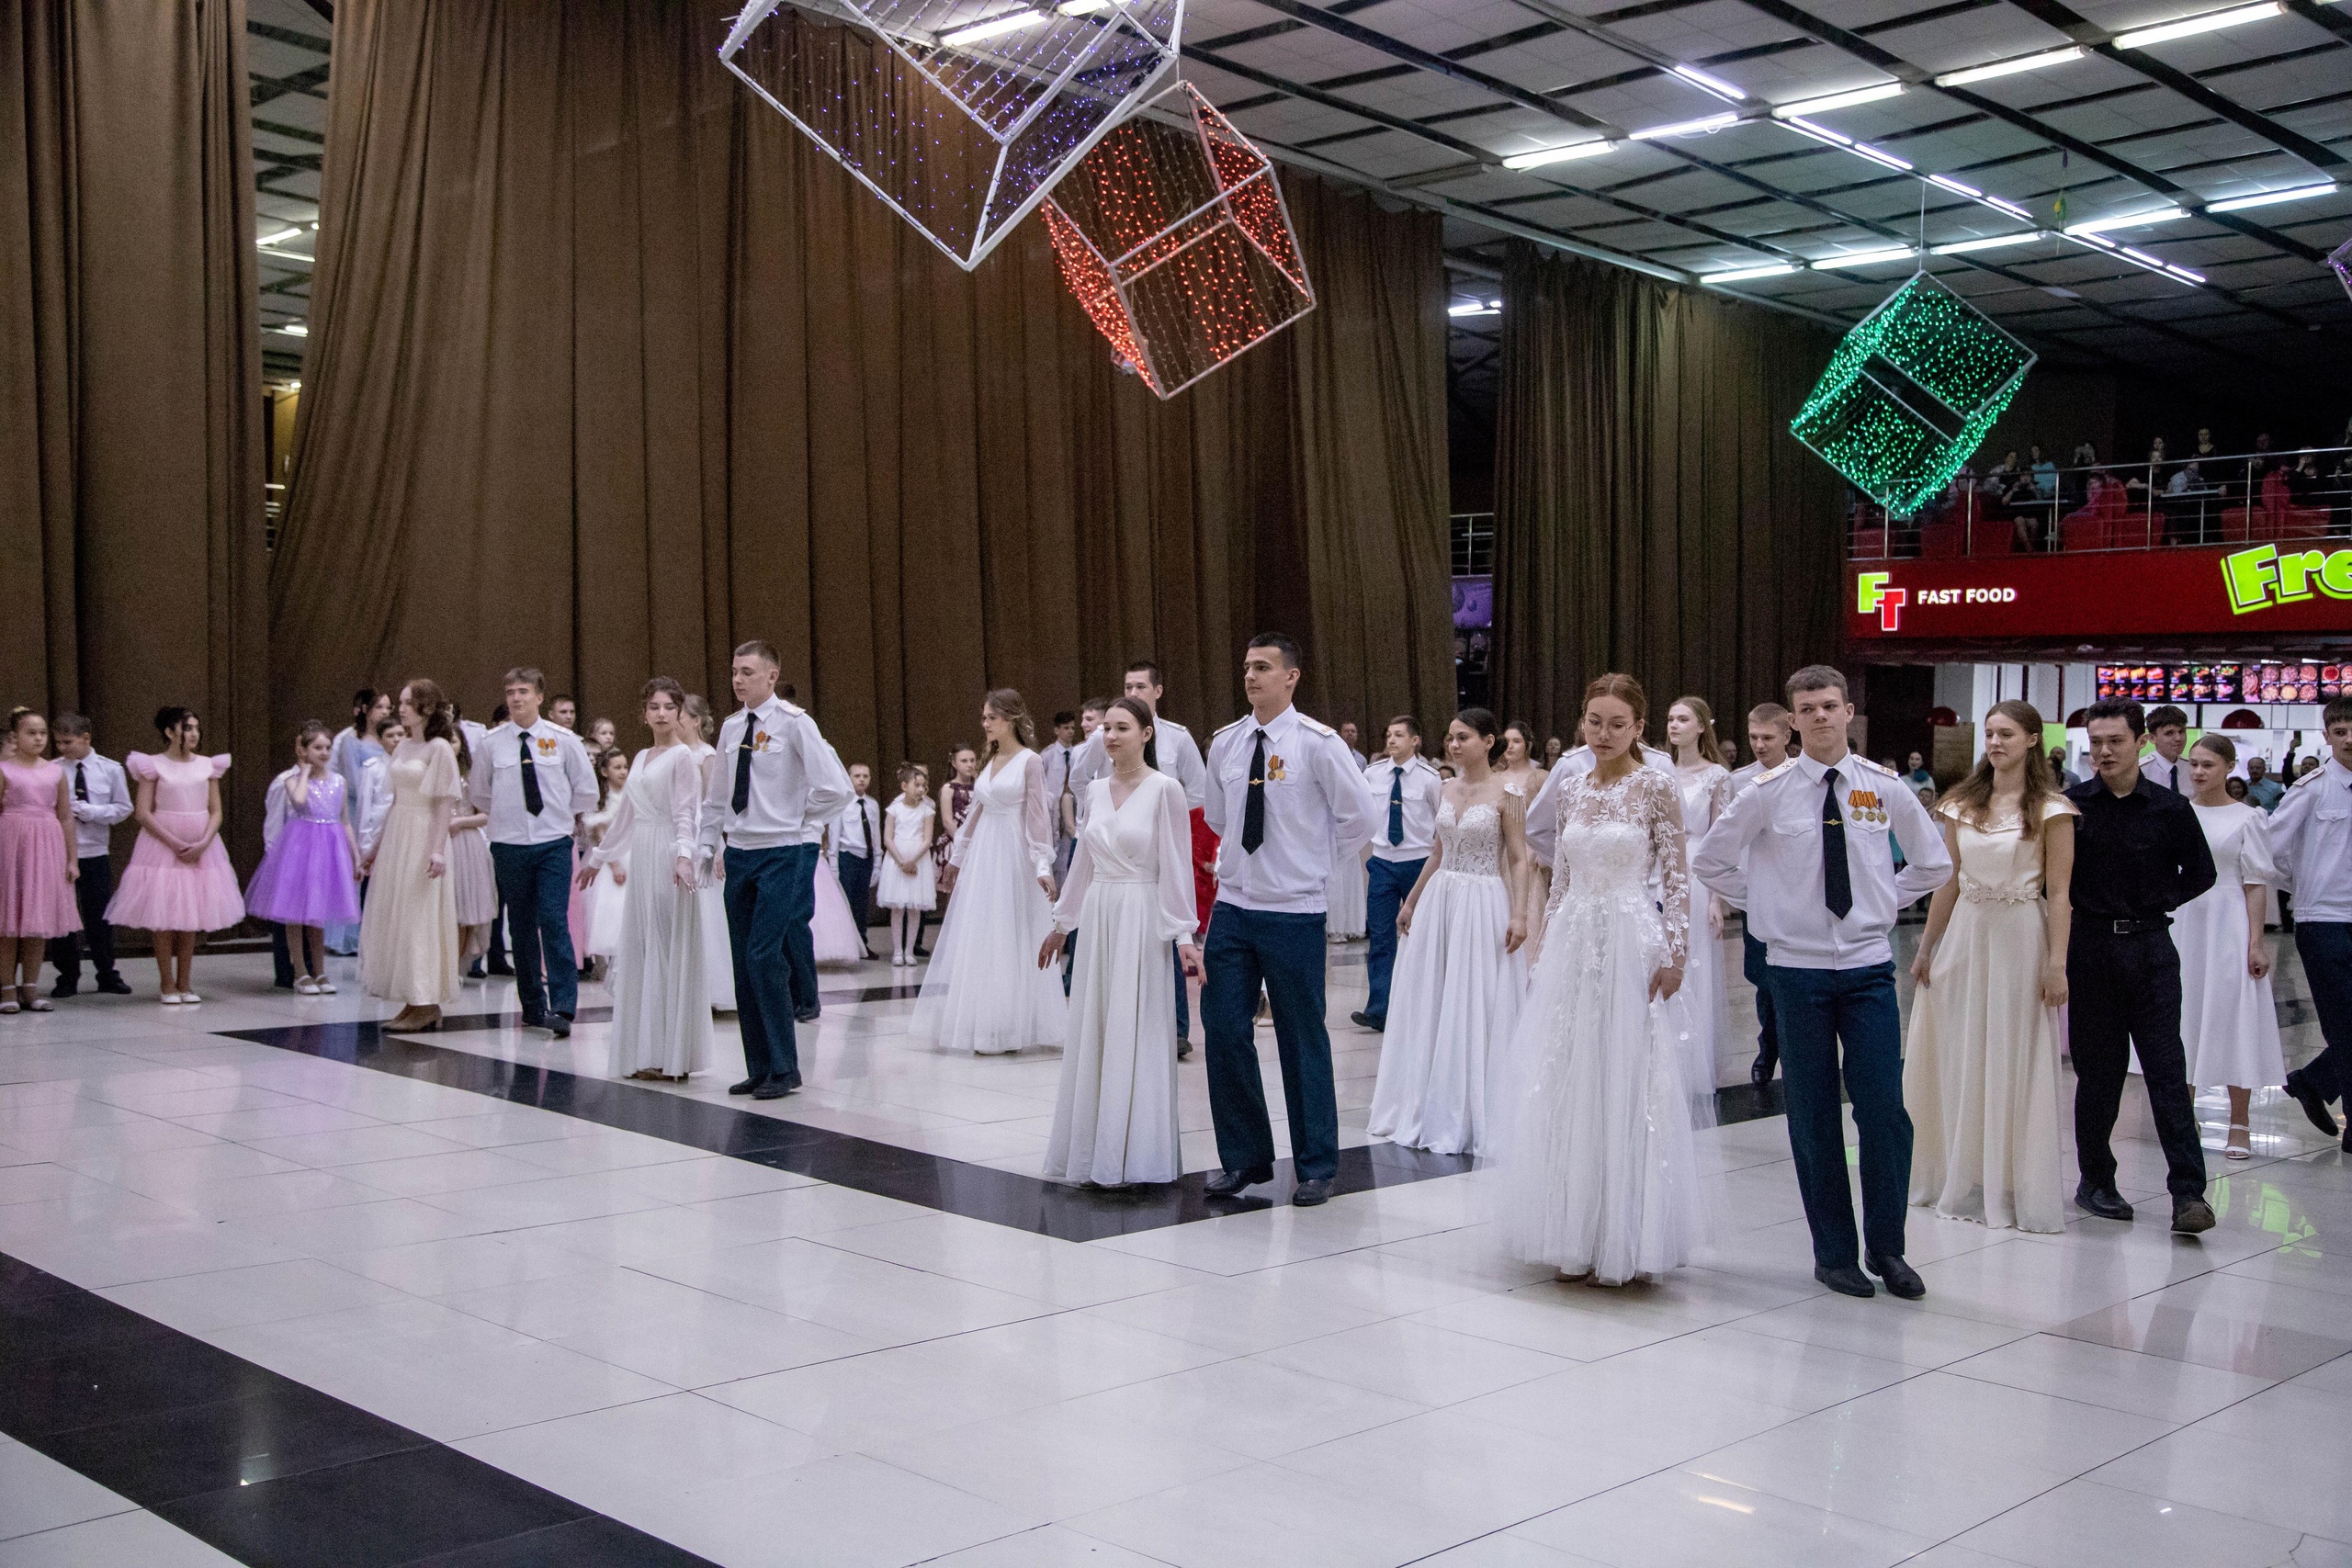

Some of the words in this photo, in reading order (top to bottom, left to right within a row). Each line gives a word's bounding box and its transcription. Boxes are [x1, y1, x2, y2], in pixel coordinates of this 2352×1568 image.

[1917, 589, 1962, 604] FAST
[1965, 587, 2016, 604] FOOD
[2221, 543, 2352, 615] Fre
